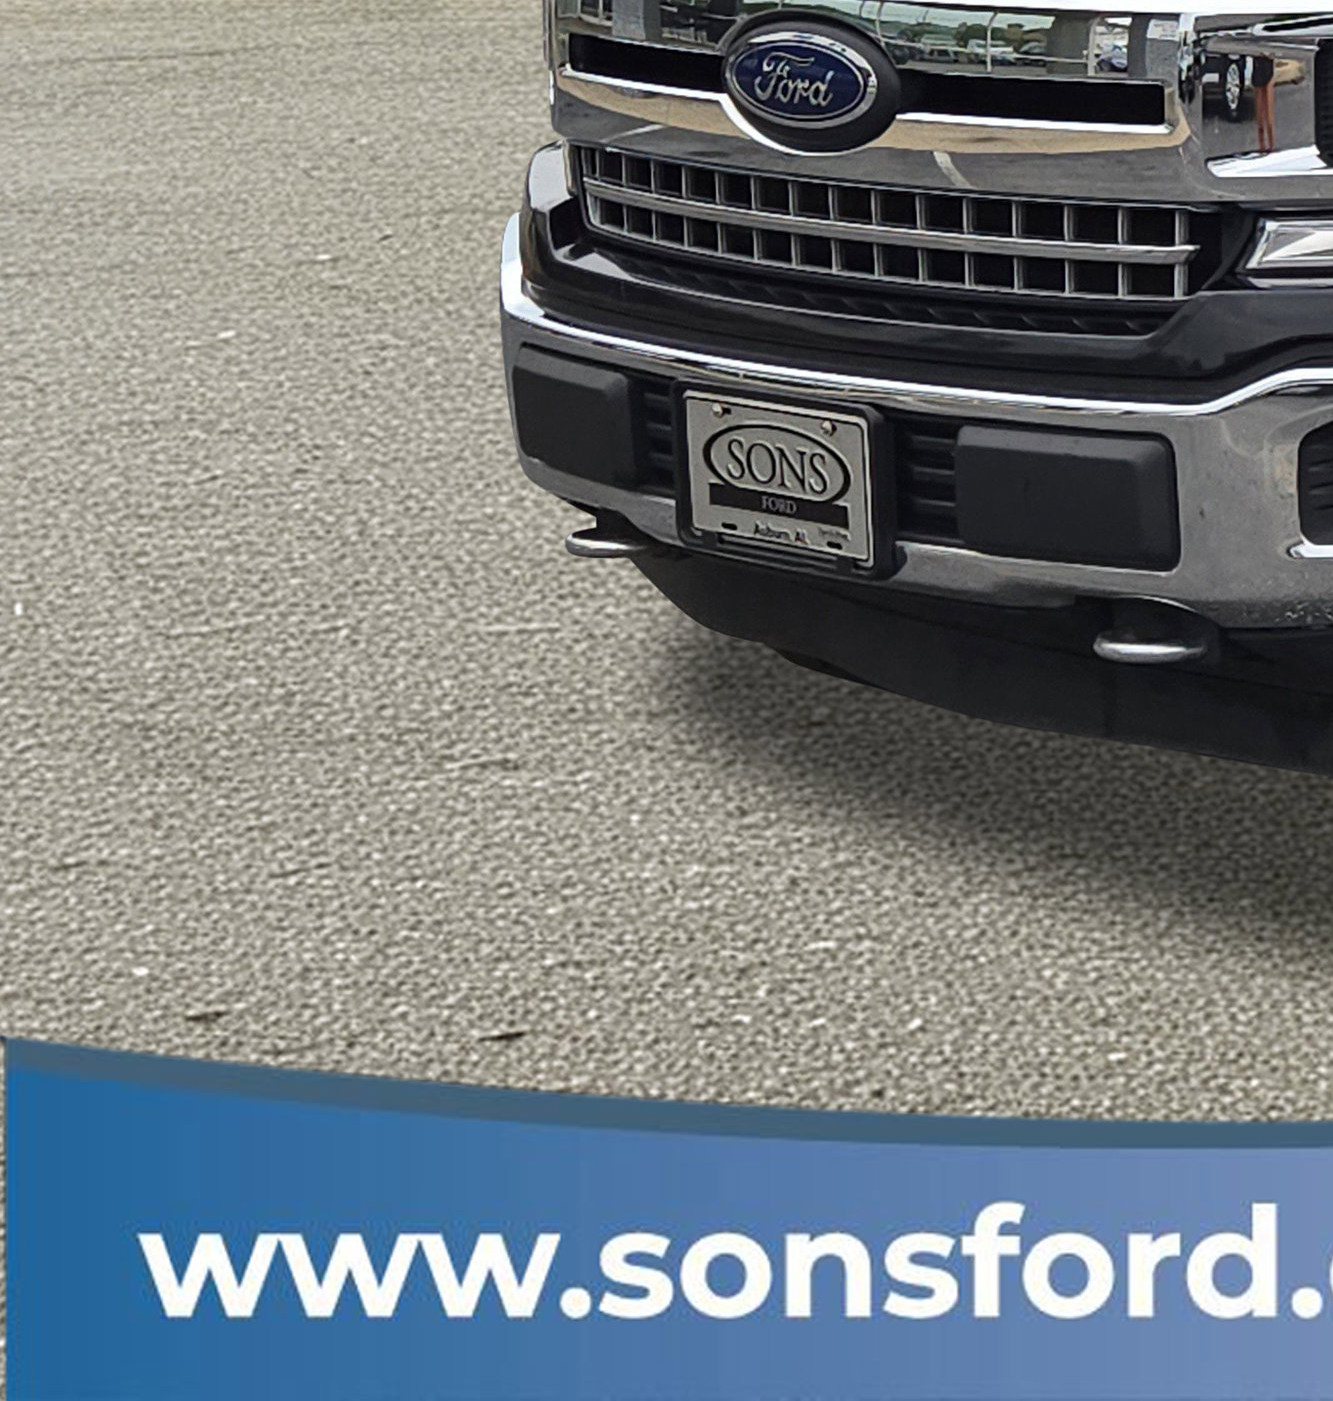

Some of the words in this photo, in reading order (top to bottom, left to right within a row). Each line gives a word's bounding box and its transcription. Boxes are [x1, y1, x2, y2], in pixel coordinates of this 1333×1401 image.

[754, 51, 834, 107] Ford
[727, 438, 828, 495] SONS
[761, 496, 797, 514] FORD
